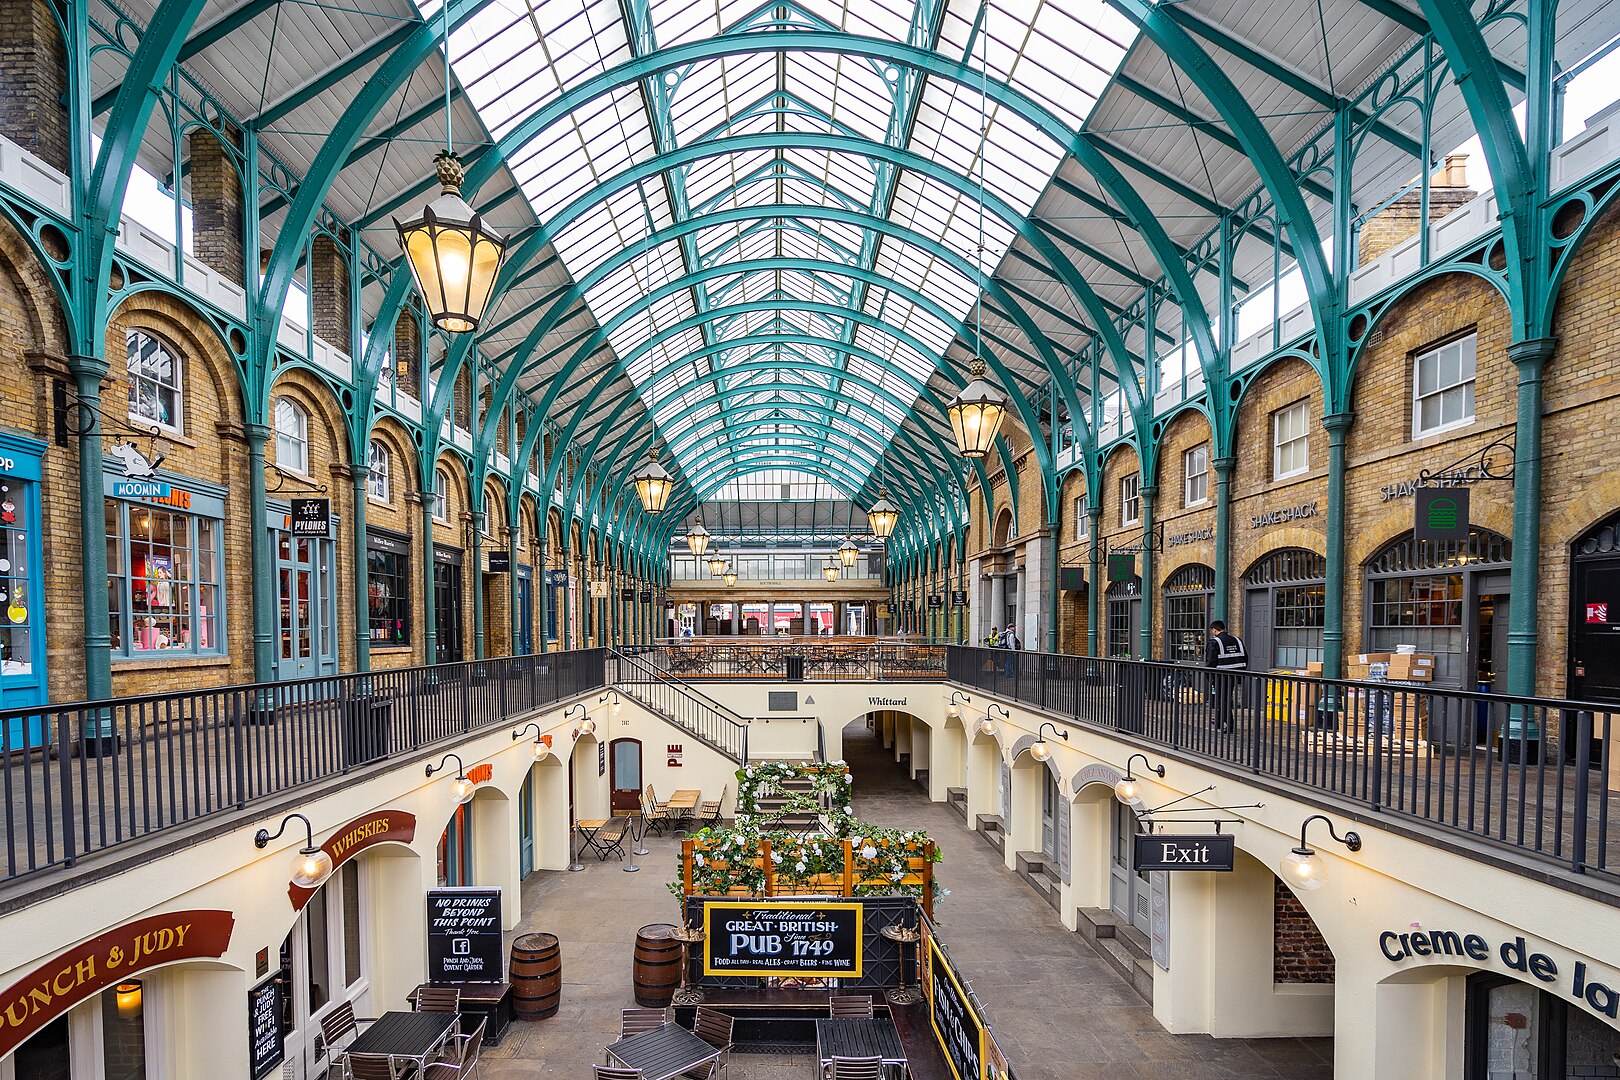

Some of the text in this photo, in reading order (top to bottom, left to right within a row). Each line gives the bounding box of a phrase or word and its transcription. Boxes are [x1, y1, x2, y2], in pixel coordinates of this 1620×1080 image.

[119, 484, 160, 495] MOOMIN
[1380, 462, 1491, 502] SHAKE SHACK
[1250, 502, 1318, 529] SHAKE SHACK
[295, 521, 327, 531] PYLONES
[1168, 527, 1213, 547] SHAKE SHACK
[868, 697, 907, 706] Whittard
[667, 744, 683, 768] PIE
[332, 818, 389, 858] WHISKIES
[1160, 843, 1210, 863] Exit
[435, 899, 492, 907] NO DRINKS
[442, 908, 485, 917] BEYOND
[752, 911, 816, 920] Traditional
[433, 917, 497, 927] THIS POINT
[444, 928, 465, 936] Thank
[783, 932, 807, 942] Since
[791, 940, 834, 956] 1749
[463, 964, 484, 972] GARDEN
[714, 957, 731, 966] FOOD
[764, 958, 781, 966] ALES
[799, 958, 818, 967] BEERS
[834, 959, 851, 967] WINE
[0, 924, 192, 1030] UNCH & JUDY
[1499, 936, 1559, 982] de
[1572, 960, 1620, 1019] la
[256, 988, 275, 1008] PUNCH
[259, 996, 275, 1014] JUDY
[257, 1008, 273, 1025] FREE
[933, 973, 950, 1020] FISH
[954, 1016, 980, 1080] CHIPS
[256, 1036, 276, 1060] HERE
